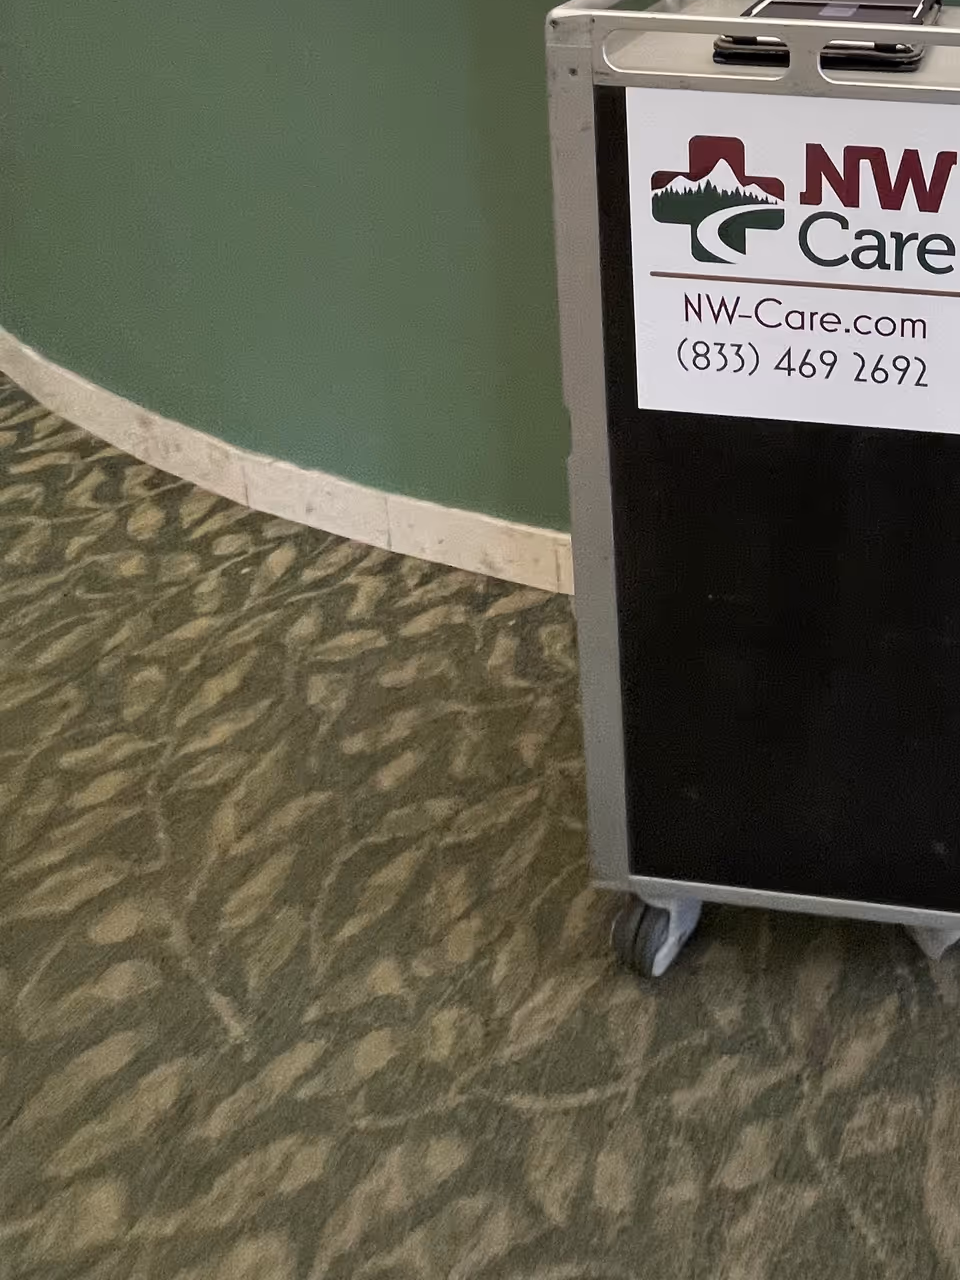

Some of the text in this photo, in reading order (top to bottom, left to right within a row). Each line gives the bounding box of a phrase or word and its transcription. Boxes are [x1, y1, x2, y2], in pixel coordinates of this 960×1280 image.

[799, 143, 958, 213] NW
[798, 211, 957, 274] Care
[684, 292, 928, 339] NW-Care.com
[677, 337, 929, 388] (833) 469 2692
